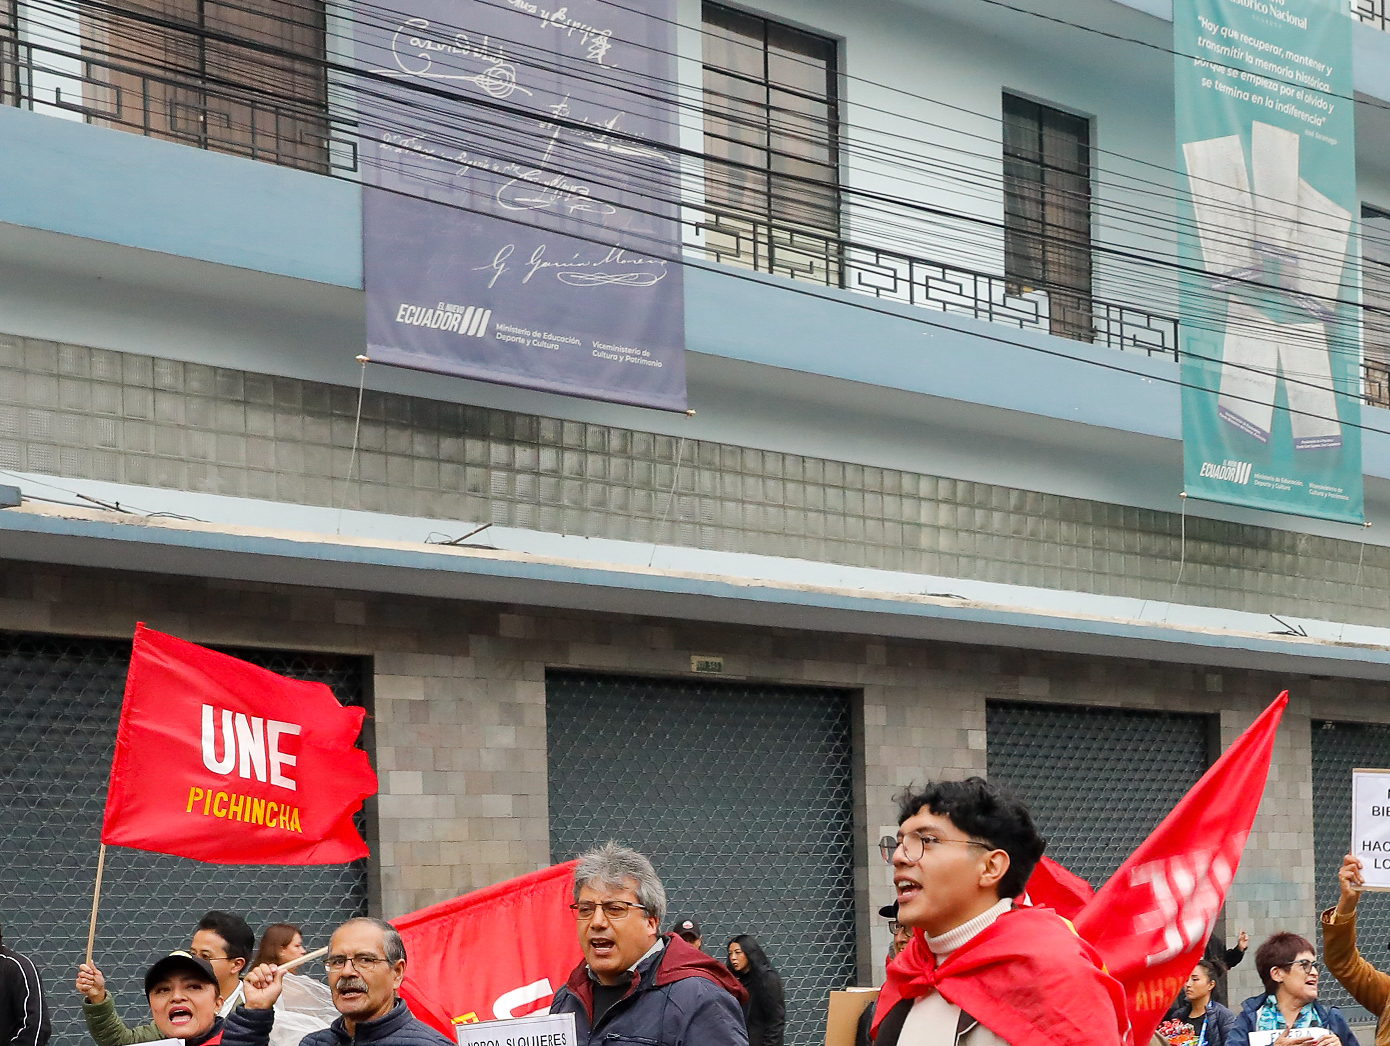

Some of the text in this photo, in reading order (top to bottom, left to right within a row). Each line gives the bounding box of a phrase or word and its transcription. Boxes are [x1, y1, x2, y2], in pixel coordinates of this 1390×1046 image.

[1269, 4, 1308, 30] Nacional
[1198, 36, 1244, 60] transmitir
[1245, 52, 1253, 64] la
[1255, 58, 1293, 78] memoria
[1221, 27, 1239, 39] que
[1240, 34, 1284, 58] recuperar,
[1285, 50, 1325, 72] mantener
[1326, 66, 1333, 76] y
[1194, 56, 1334, 114] porque se empieza por el olvido y
[1201, 77, 1212, 88] se
[1214, 80, 1250, 101] termina
[1251, 94, 1263, 105] en
[1265, 96, 1274, 108] la
[396, 303, 462, 332] ECUADOR
[437, 301, 465, 314] EL NUEVO
[495, 323, 582, 346] Ministerio de Educación,
[496, 332, 559, 350] Deporte y Cultura
[592, 340, 641, 356] Viceministerio
[592, 350, 618, 361] Cultura
[625, 355, 663, 368] Patrimonio
[1200, 462, 1236, 482] ECUADOR
[201, 703, 302, 791] UNE
[186, 786, 303, 833] PICHINCHA
